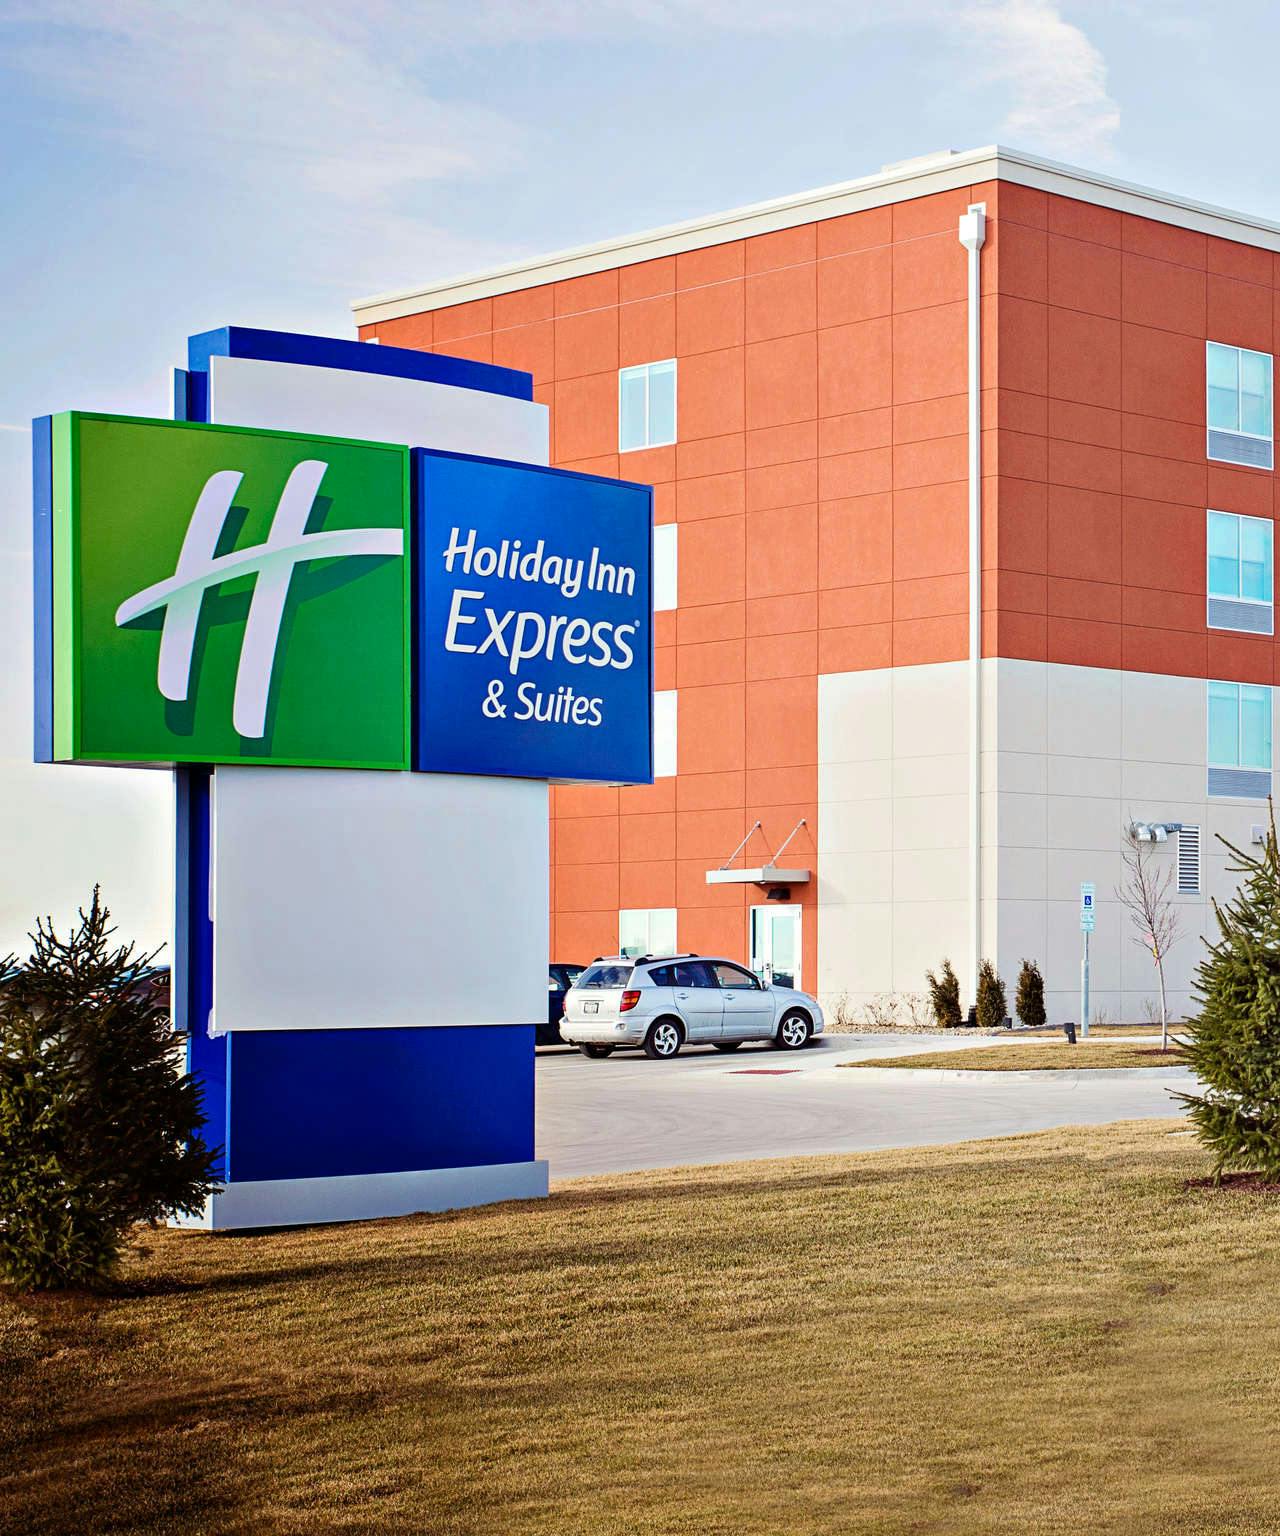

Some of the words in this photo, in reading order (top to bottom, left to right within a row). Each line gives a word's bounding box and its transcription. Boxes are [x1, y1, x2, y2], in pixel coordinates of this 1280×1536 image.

[442, 527, 584, 598] Holiday
[587, 547, 636, 596] Inn
[444, 588, 636, 675] Express
[481, 679, 507, 719] &
[514, 681, 604, 727] Suites
